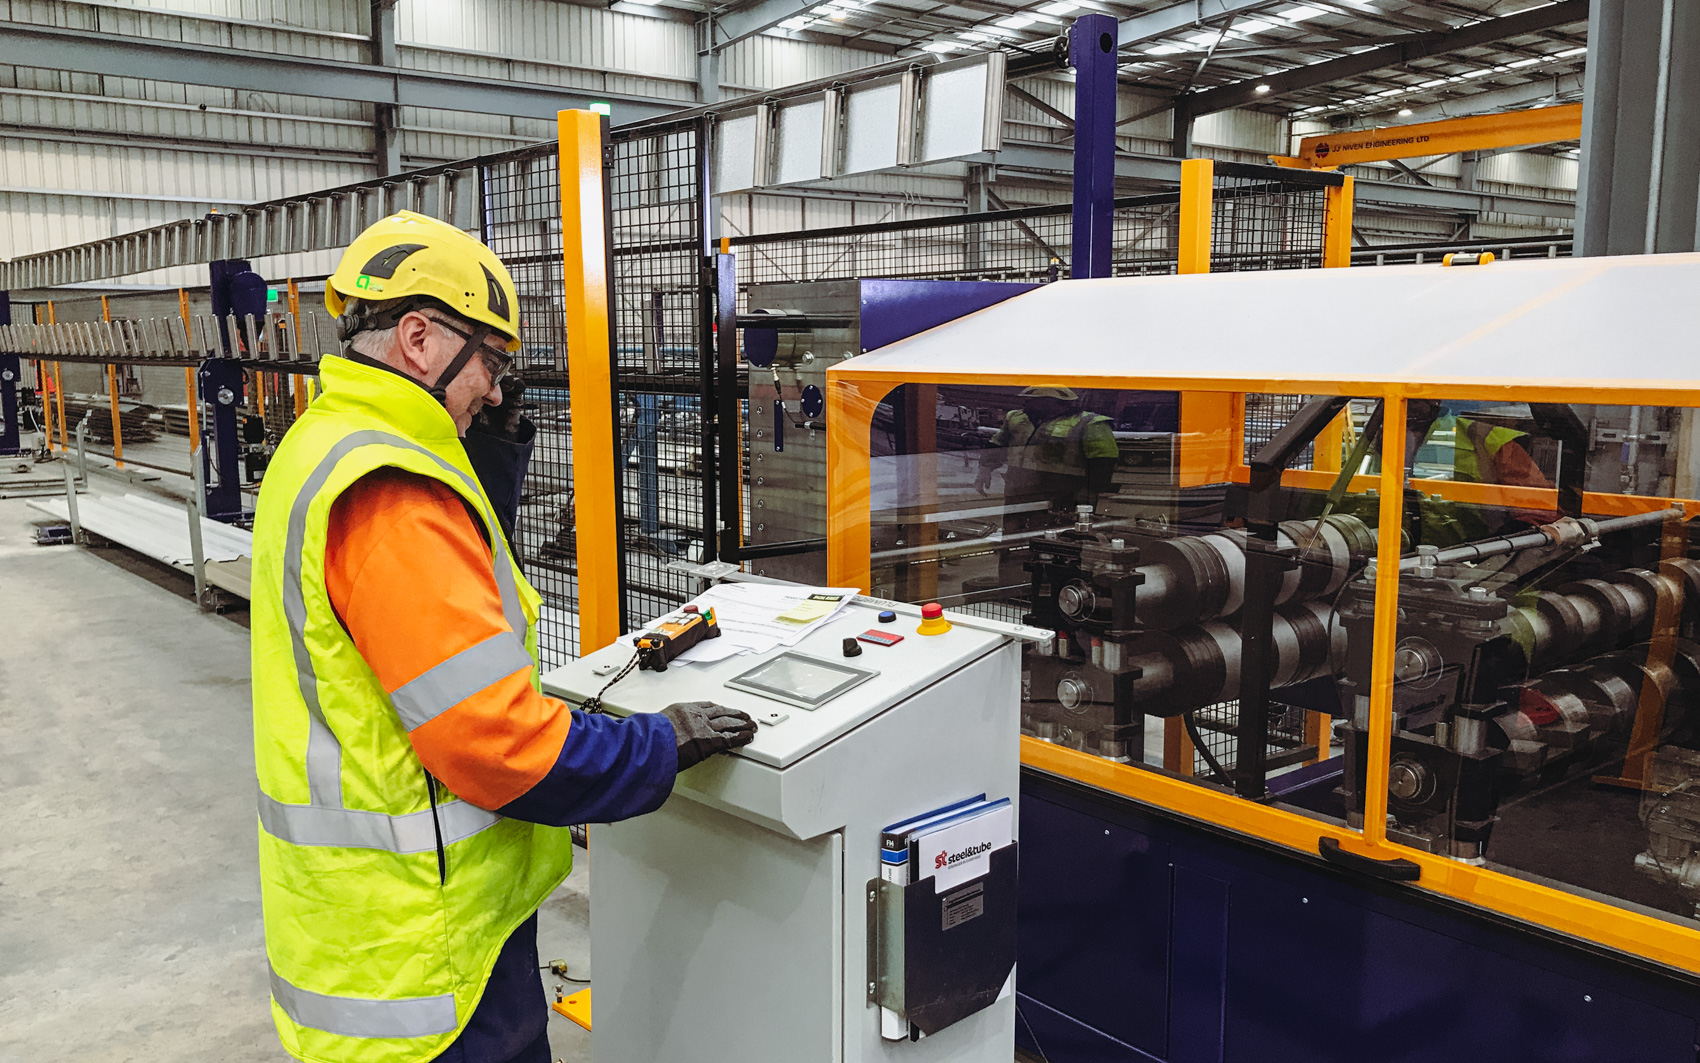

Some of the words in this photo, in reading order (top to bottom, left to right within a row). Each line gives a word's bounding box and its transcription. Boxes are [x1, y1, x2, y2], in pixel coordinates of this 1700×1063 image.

[1343, 143, 1363, 151] NIVEN
[1365, 138, 1414, 149] ENGINEERING
[948, 842, 991, 864] steel&tube
